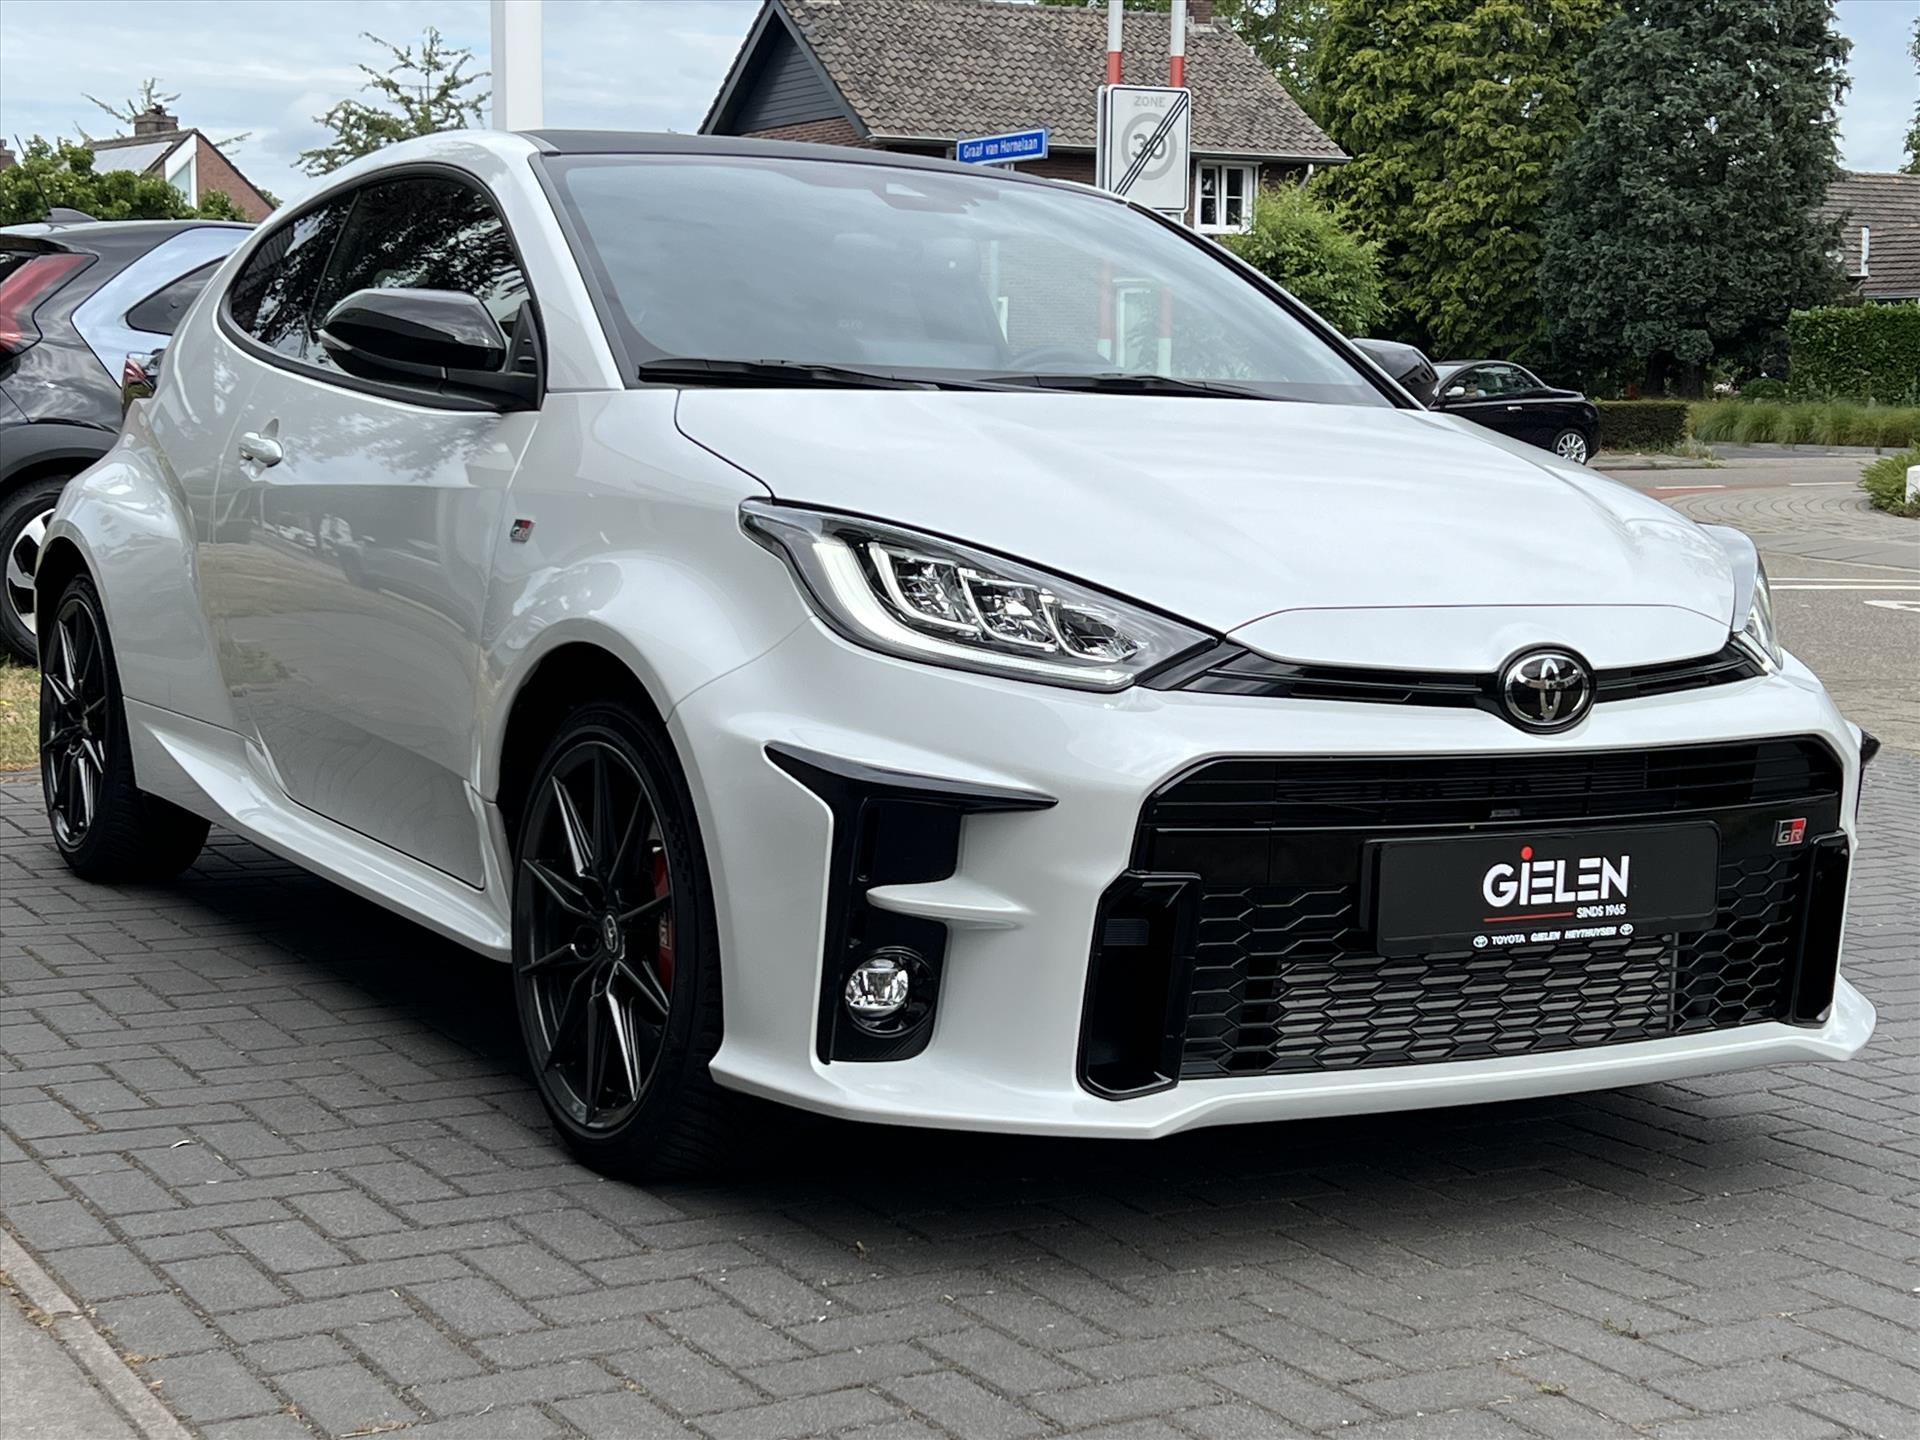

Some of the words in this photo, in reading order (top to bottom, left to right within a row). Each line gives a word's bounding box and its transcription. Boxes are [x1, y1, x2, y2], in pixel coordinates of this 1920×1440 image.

[1134, 96, 1166, 108] ZONE
[963, 142, 984, 158] Graaf
[985, 143, 999, 155] van
[1131, 133, 1167, 160] 30
[1779, 829, 1804, 843] GR
[1576, 905, 1604, 919] SINDS
[1605, 903, 1627, 917] 1965
[1491, 934, 1526, 946] TOYOTA
[1530, 930, 1561, 943] GIELEN
